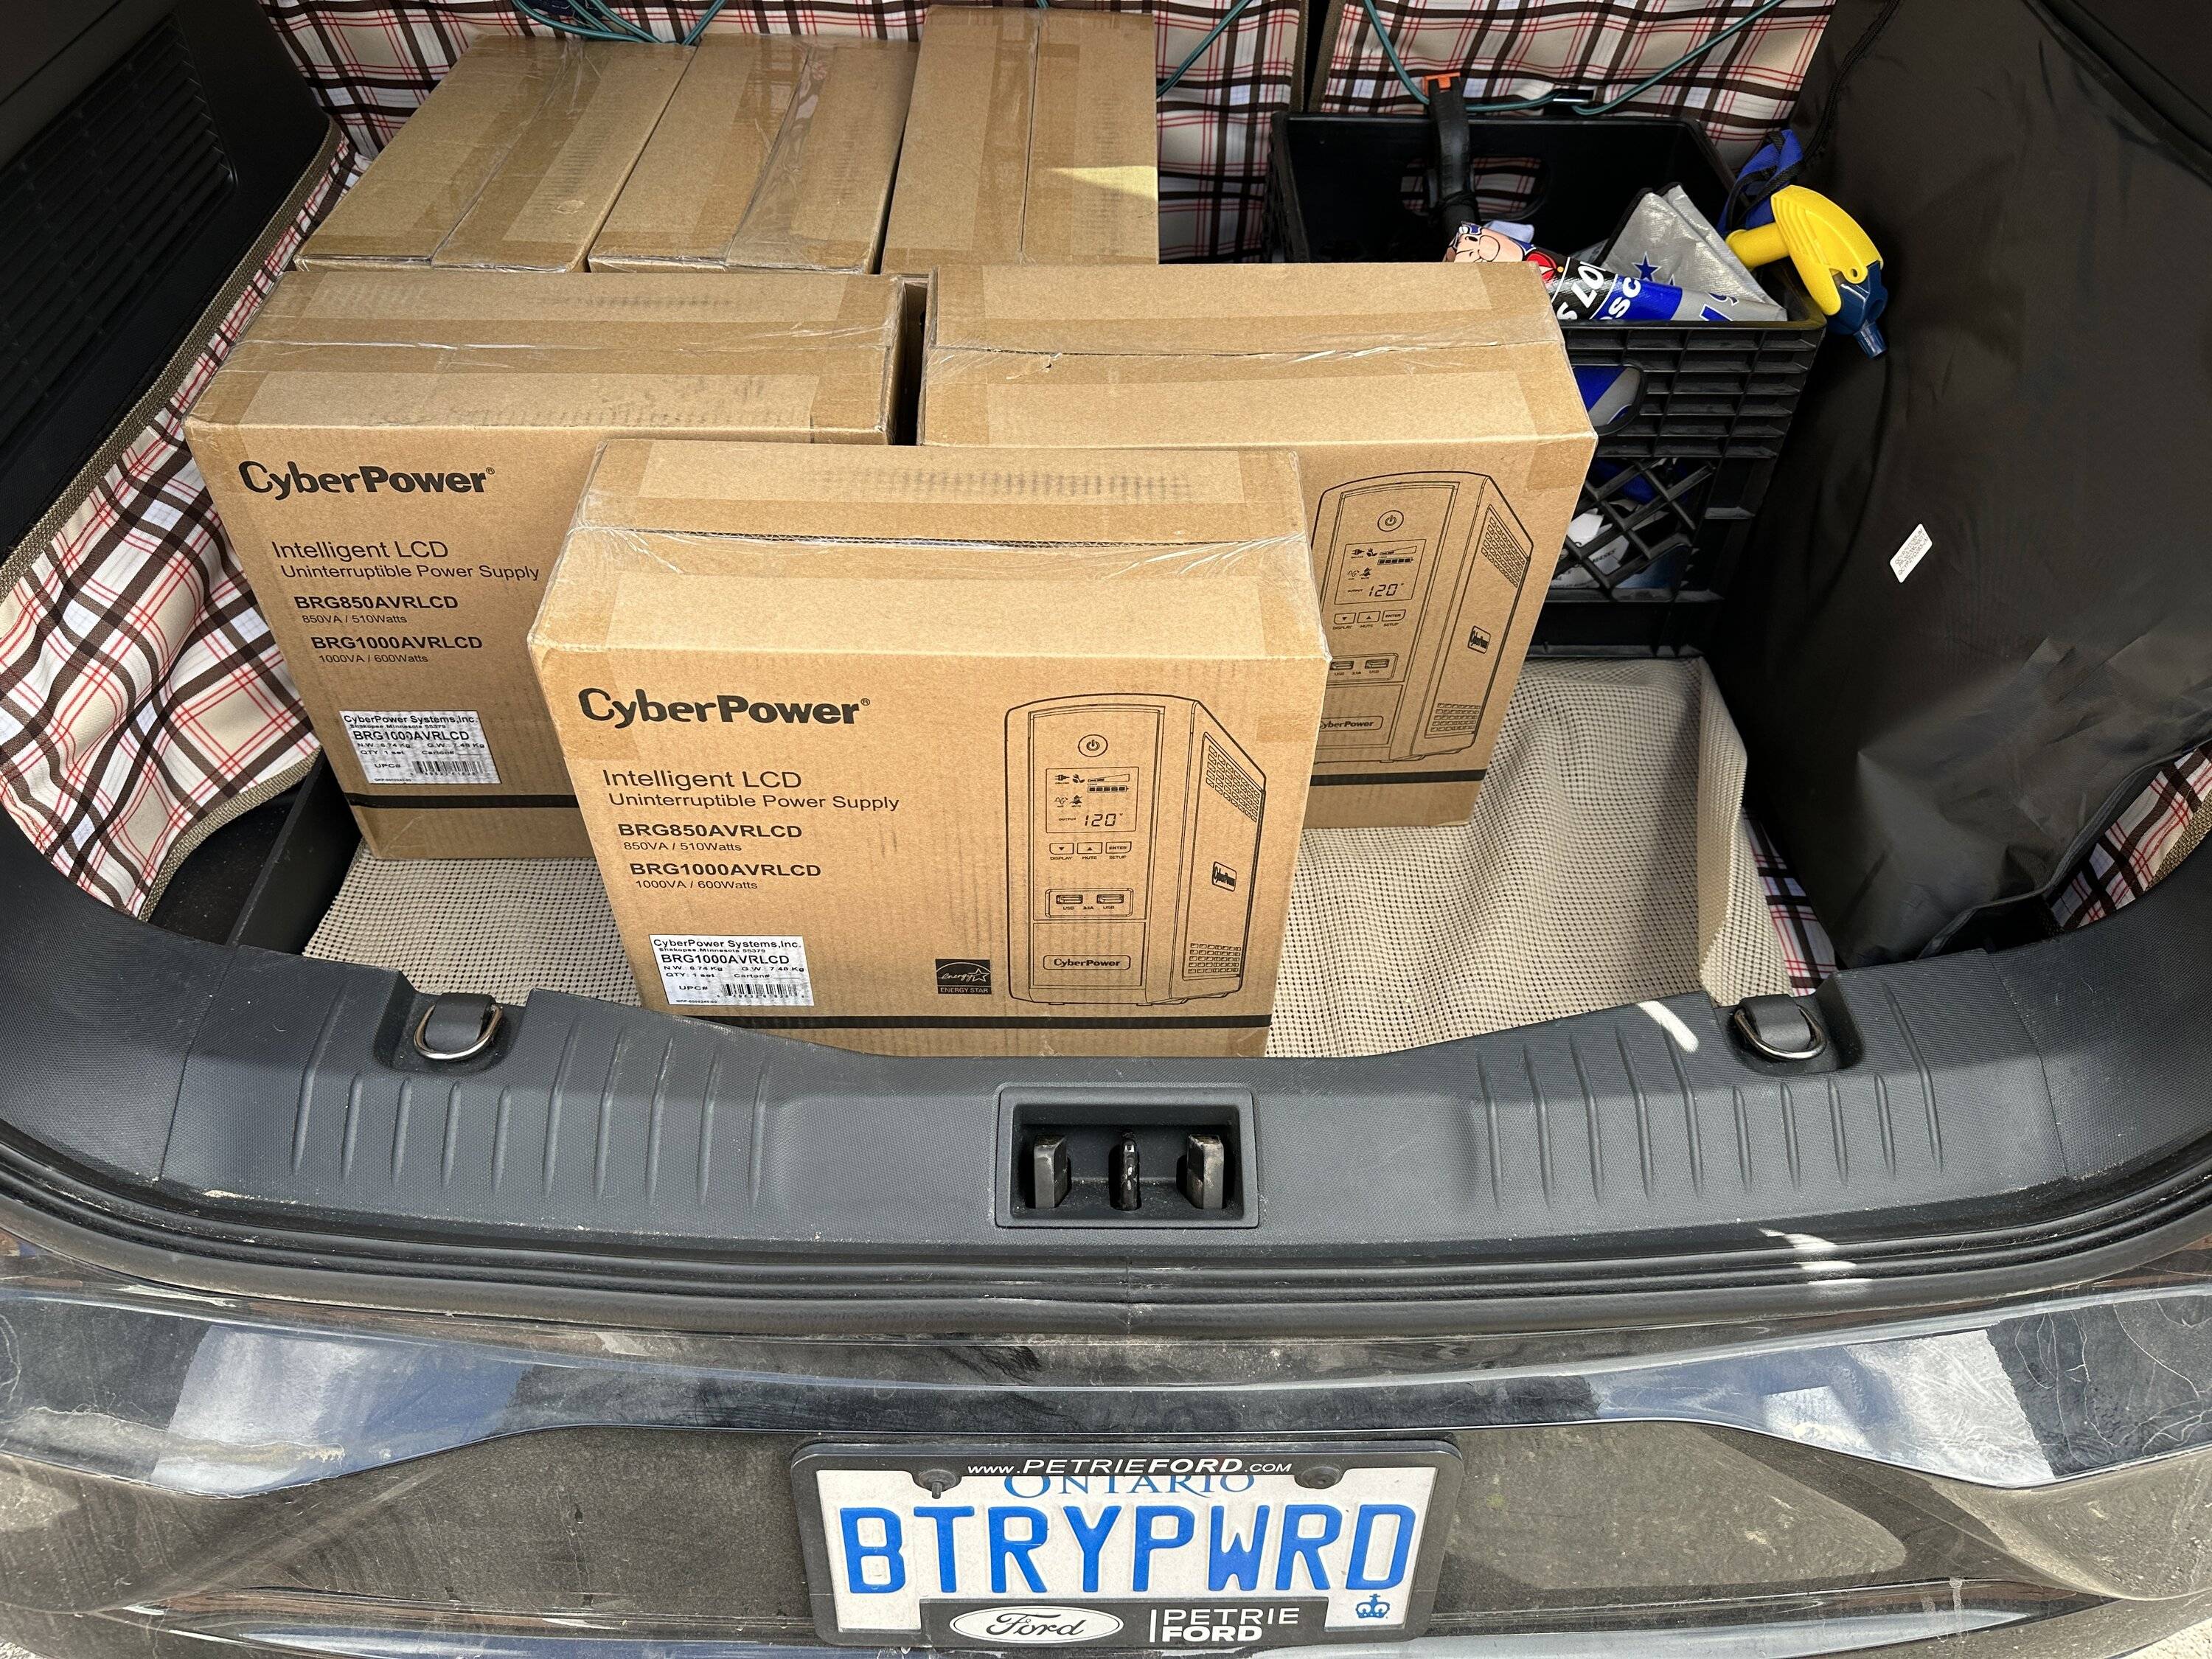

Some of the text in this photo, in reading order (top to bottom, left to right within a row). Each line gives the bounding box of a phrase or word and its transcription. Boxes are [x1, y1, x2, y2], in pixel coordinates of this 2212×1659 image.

[271, 540, 449, 563] Intelligent LCD
[280, 565, 540, 581] Uninterruptible Power Supply
[1368, 583, 1399, 597] 120
[293, 596, 459, 609] BRG850AVRLCD
[302, 615, 342, 624] 850VA
[352, 615, 408, 624] 510Watts
[310, 636, 483, 650] BRG1000AVRLCD
[319, 654, 364, 664] 1000VA
[373, 654, 429, 664] 600Watts
[344, 715, 479, 725] CyberPower Systems,Inc.
[352, 731, 470, 741] BRG1000AVRLCD
[602, 769, 802, 791] Intelligent LCD
[608, 793, 900, 812] Uninterruptible Power Supply
[1085, 813, 1117, 827] 120
[618, 824, 802, 838] BRG850AVRLCD
[623, 841, 669, 851] 850VA
[680, 842, 742, 852] 510Watts
[629, 863, 821, 877] BRG1000AVRLCD
[635, 880, 686, 889] 1000VA
[698, 880, 758, 890] 600Watts
[653, 939, 801, 949] CyberPower Systems,Inc.
[661, 954, 790, 964] BRG1000AVRLCD
[1054, 958, 1121, 968] CyberPower
[839, 1503, 1417, 1594] BTRYPWRD
[986, 1612, 1087, 1635] Ford
[1163, 1607, 1300, 1626] PETRIE
[1161, 1625, 1263, 1642] FORD
